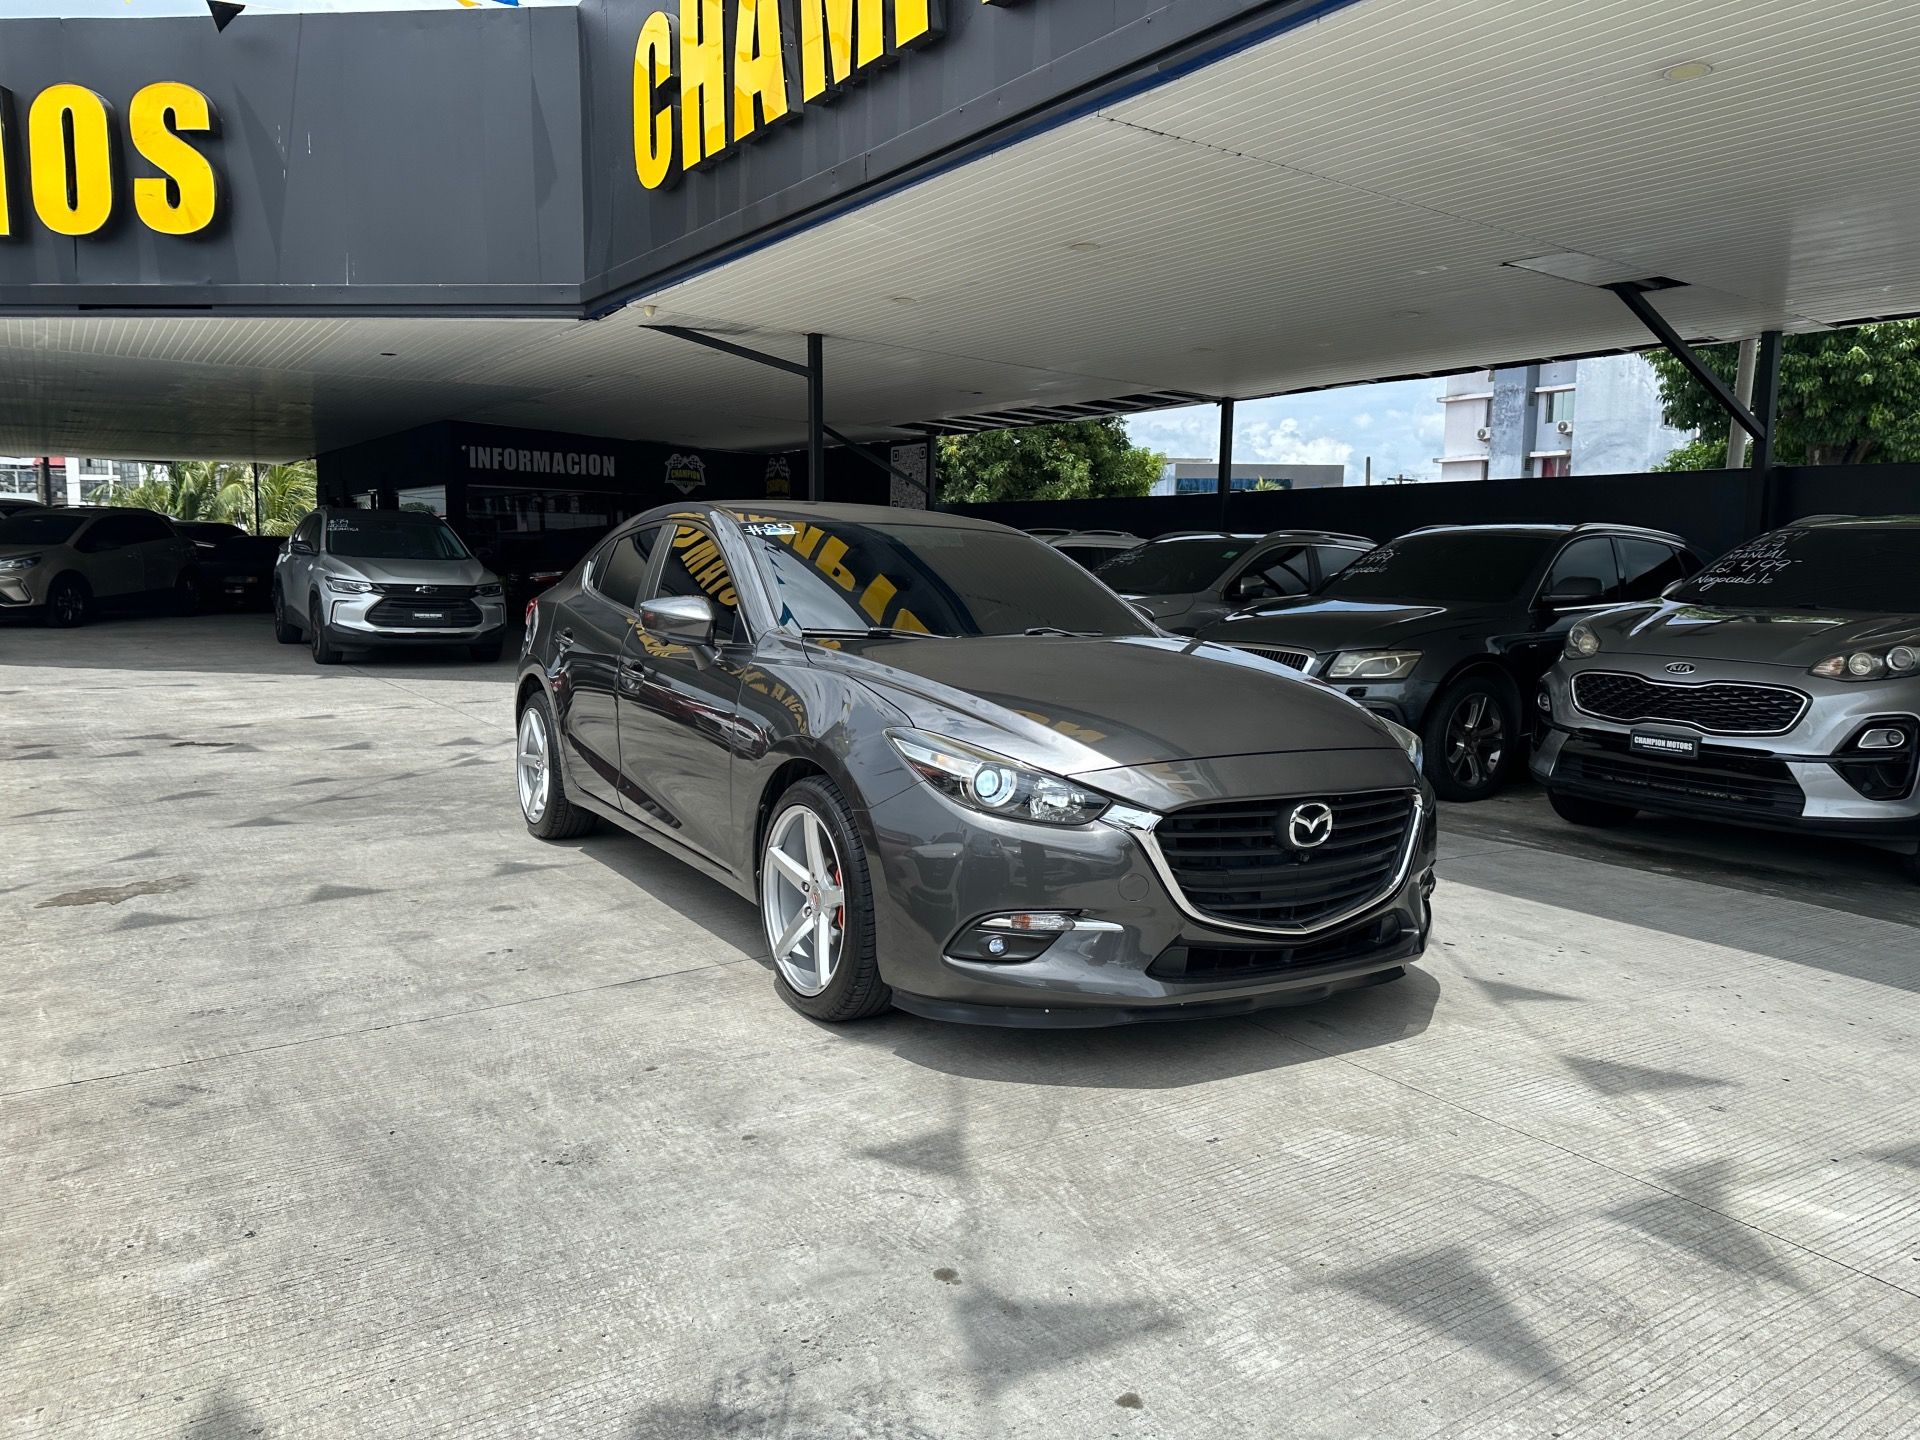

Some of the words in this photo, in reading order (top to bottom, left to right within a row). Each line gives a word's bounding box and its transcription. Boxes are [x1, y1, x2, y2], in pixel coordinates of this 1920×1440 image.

[0, 81, 217, 236] OS
[468, 445, 616, 478] INFORMACION
[1633, 735, 1666, 747] CHAMPION
[1666, 740, 1693, 751] MOTORS
